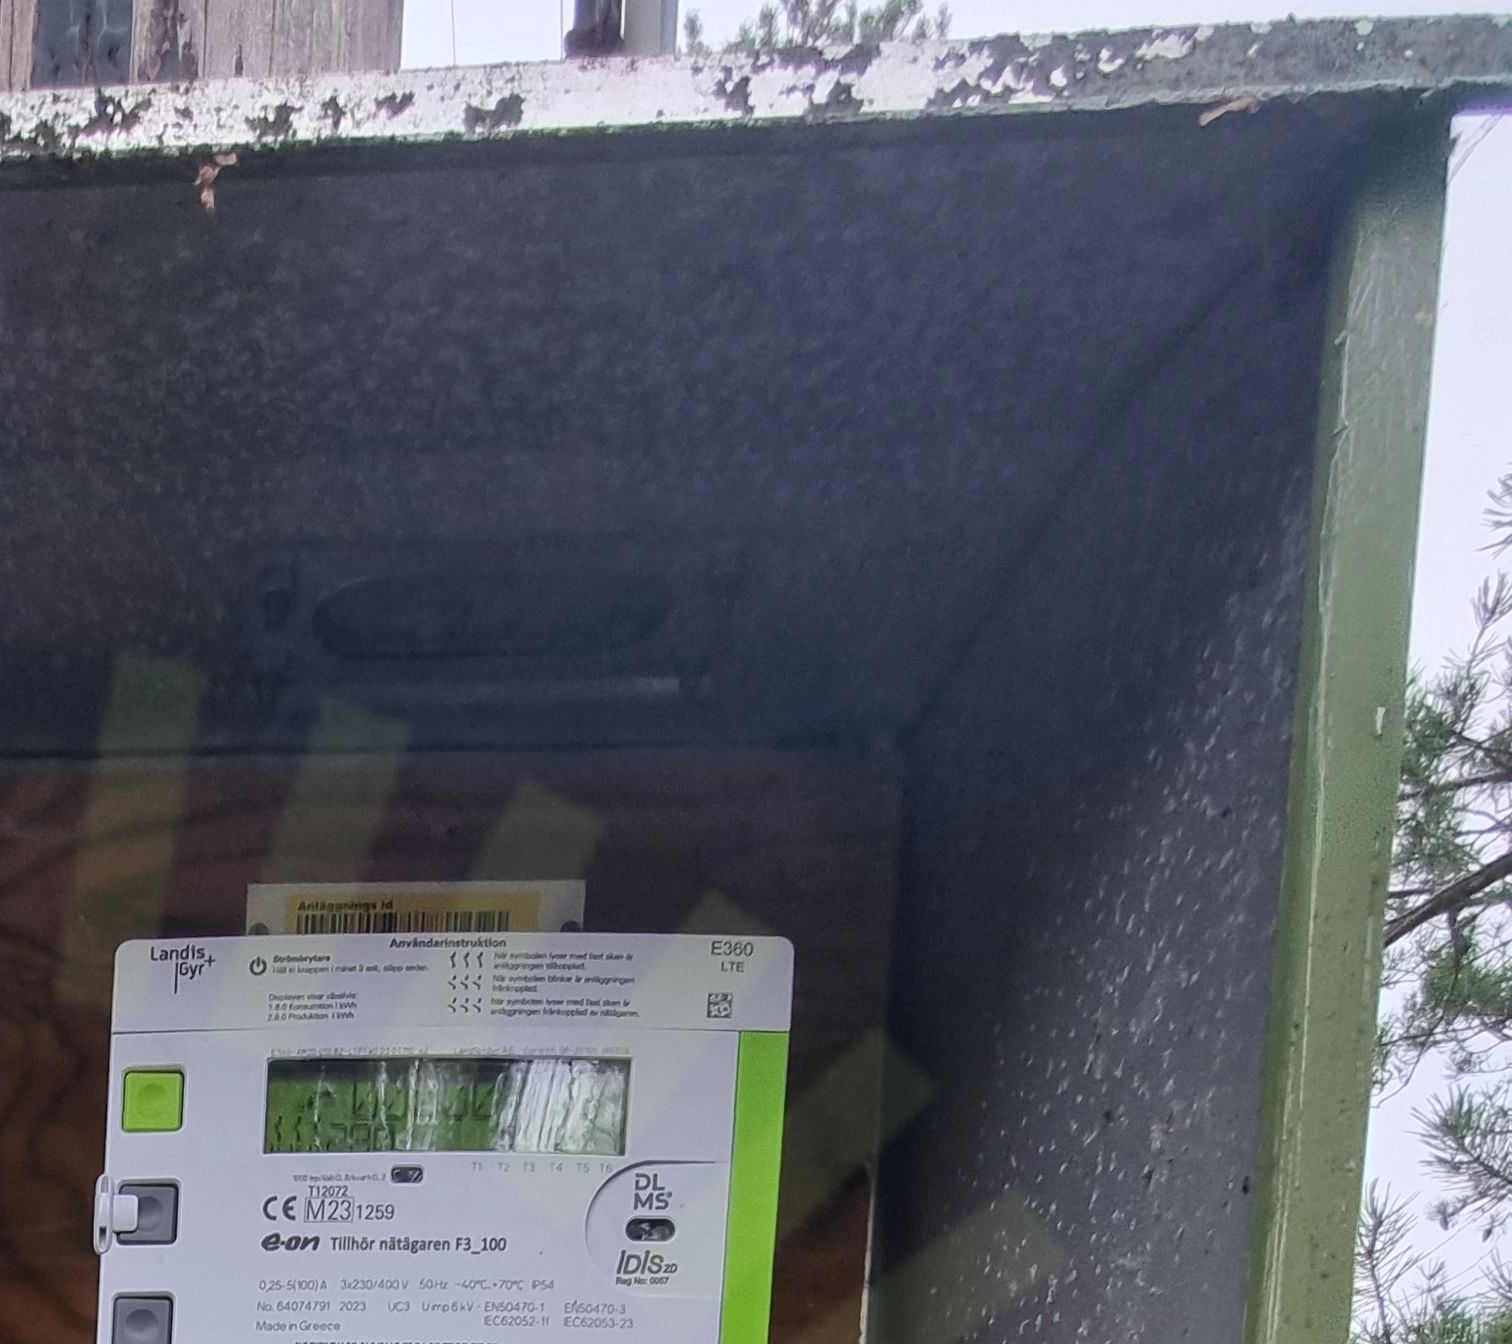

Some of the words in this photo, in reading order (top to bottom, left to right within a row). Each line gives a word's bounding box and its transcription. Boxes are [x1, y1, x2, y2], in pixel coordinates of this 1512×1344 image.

[711, 941, 754, 957] E360
[720, 961, 745, 973] LTE
[306, 1200, 352, 1221] M23
[356, 1204, 395, 1220] 1259
[330, 1236, 375, 1251] Tillhör
[379, 1236, 450, 1253] nätägaren
[455, 1237, 507, 1254] F3_100
[339, 1301, 366, 1312] 2023
